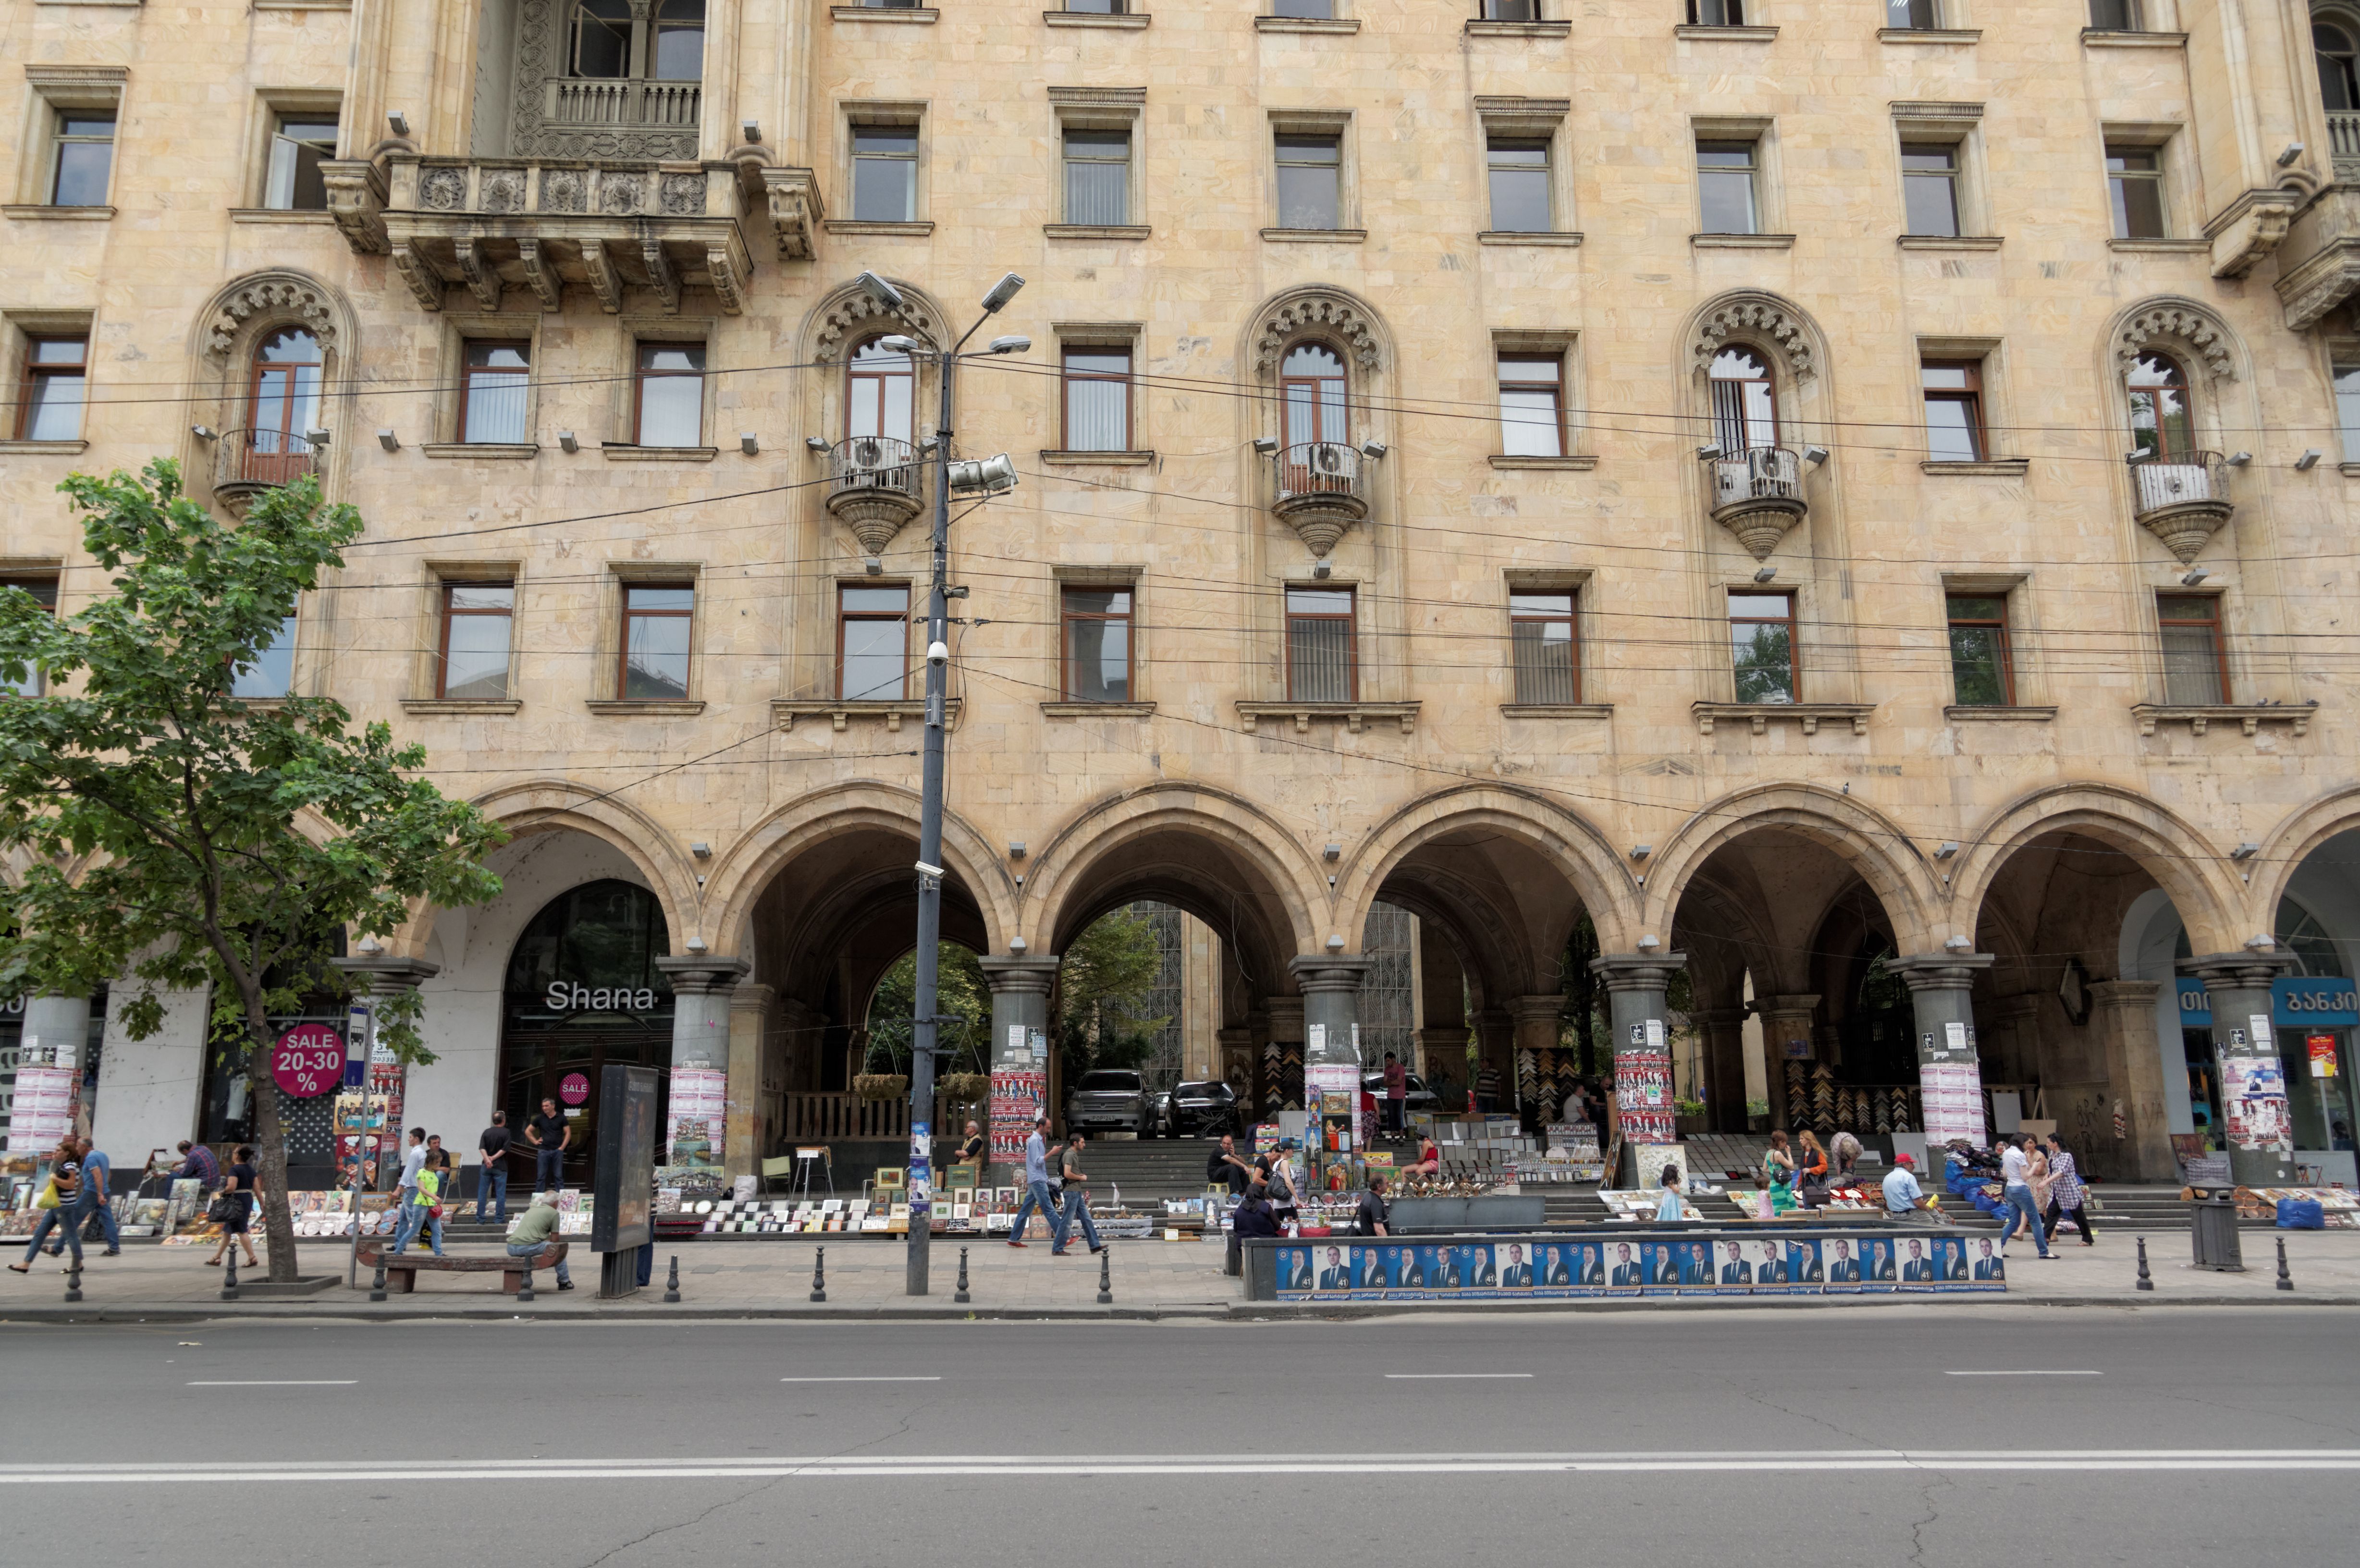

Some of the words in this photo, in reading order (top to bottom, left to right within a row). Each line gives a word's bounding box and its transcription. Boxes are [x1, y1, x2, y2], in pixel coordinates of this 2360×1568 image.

[546, 981, 653, 1009] Shana
[2286, 992, 2358, 1011] ბანკი
[287, 1034, 333, 1048] SALE
[278, 1052, 339, 1070] 20-30
[297, 1073, 317, 1091] %
[562, 1084, 587, 1092] SALE
